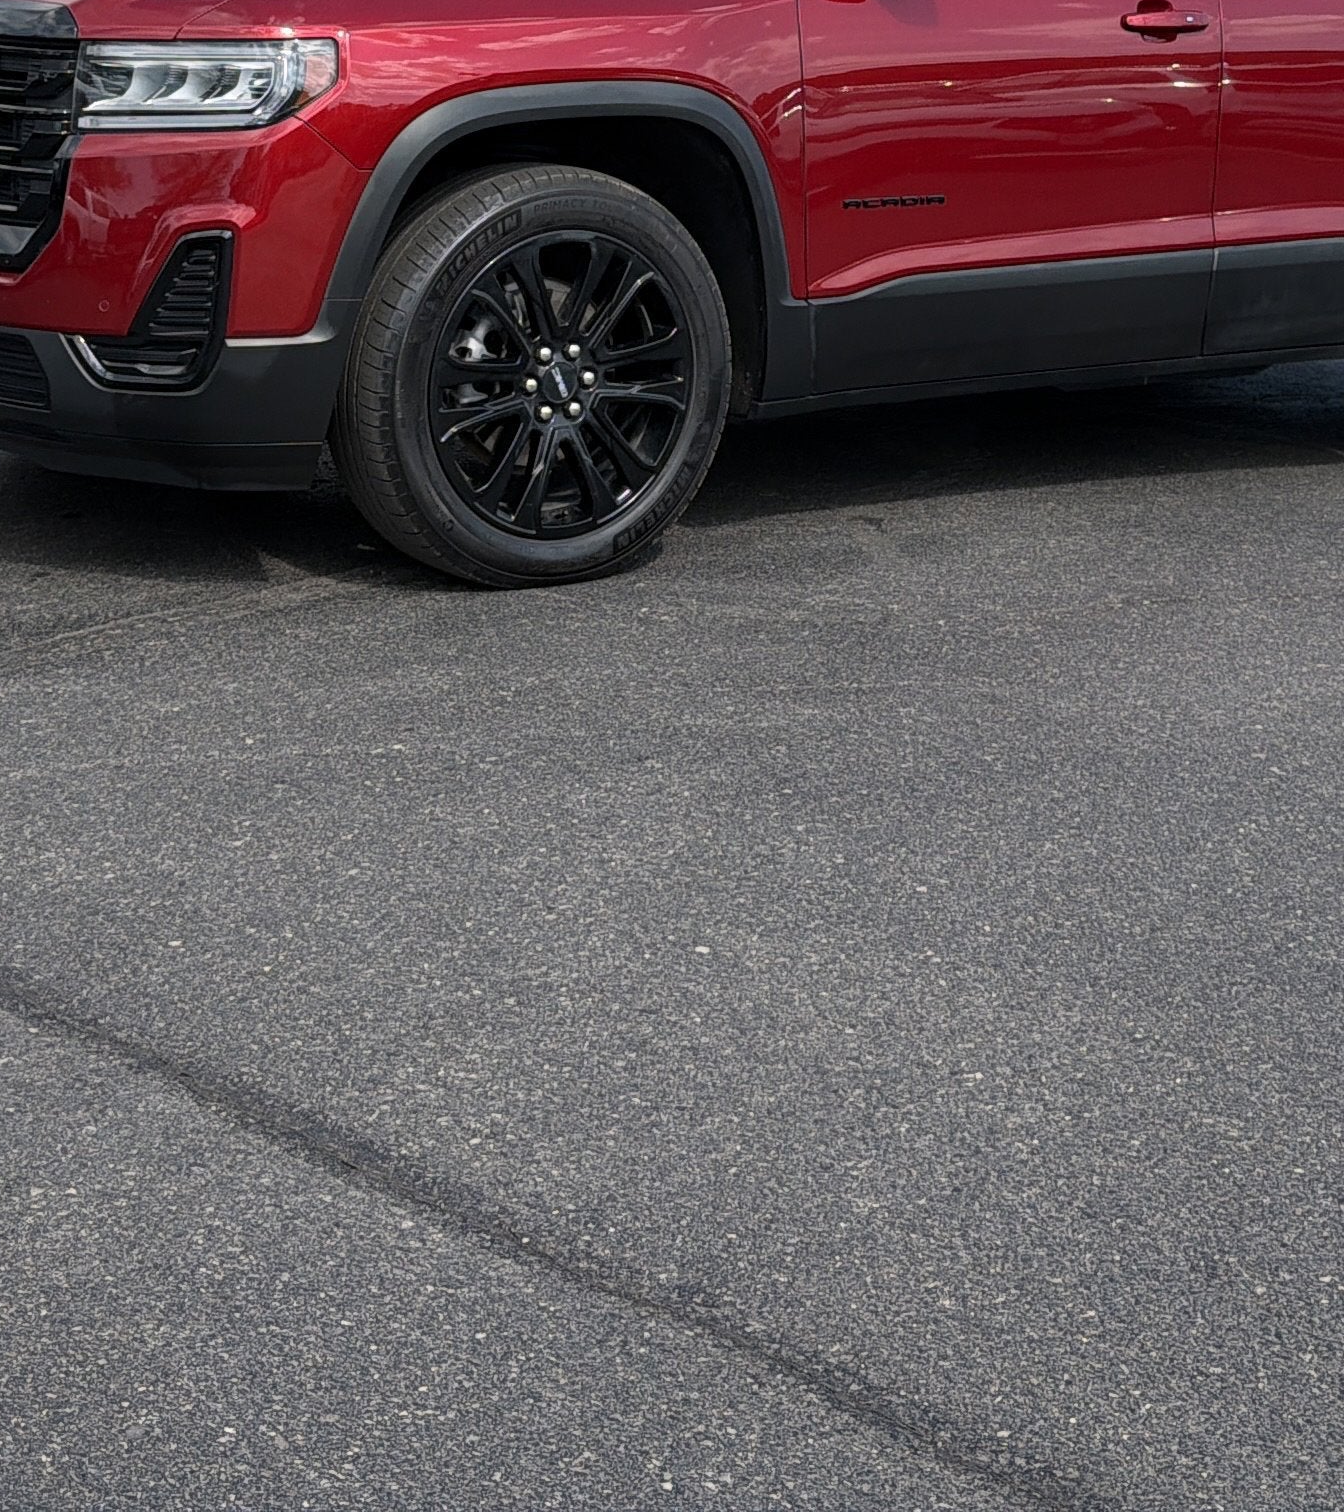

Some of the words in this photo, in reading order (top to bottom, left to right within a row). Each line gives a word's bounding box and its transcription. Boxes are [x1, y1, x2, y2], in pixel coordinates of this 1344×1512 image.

[842, 194, 946, 210] ACADIA
[437, 213, 521, 297] MICHELIN
[616, 464, 694, 549] MICHELIN
